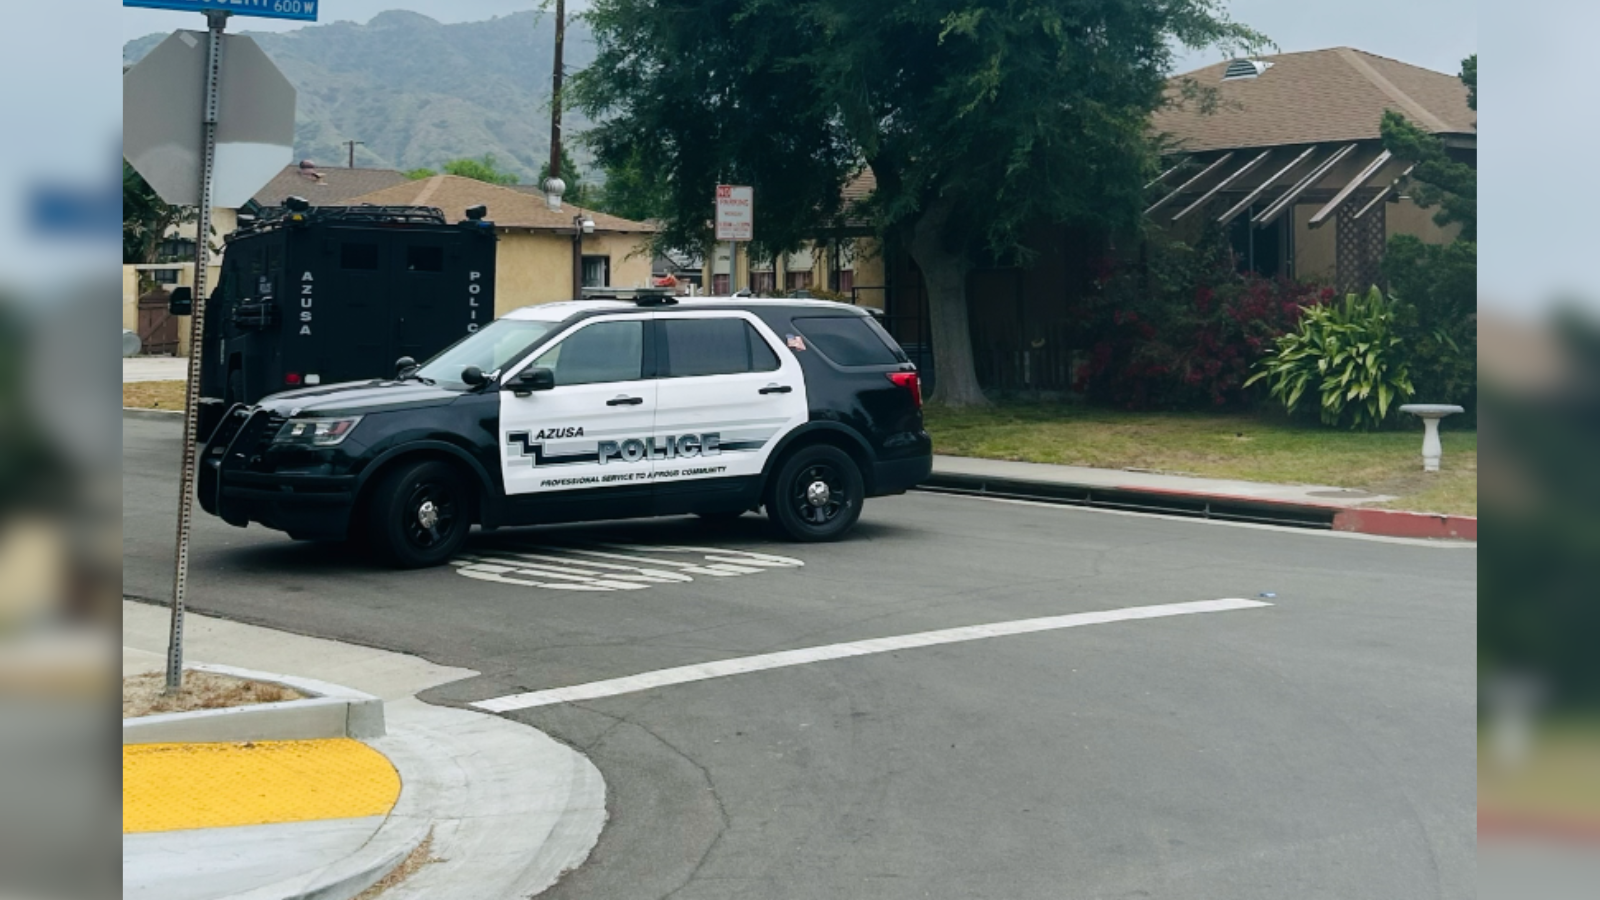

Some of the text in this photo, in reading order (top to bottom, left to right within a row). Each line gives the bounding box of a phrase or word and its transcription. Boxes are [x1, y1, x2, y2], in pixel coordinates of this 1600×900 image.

[274, 0, 301, 12] 600
[303, 1, 314, 14] W
[300, 271, 314, 335] AZUSA
[467, 271, 481, 333] POLIC
[535, 426, 584, 440] AZUSA
[597, 432, 721, 465] POLICE
[540, 473, 600, 487] PROFESSIONAL
[601, 472, 634, 483] SERVICE
[635, 472, 647, 480] TO
[653, 468, 680, 479] PROUD
[681, 465, 728, 477] COMMUNITY
